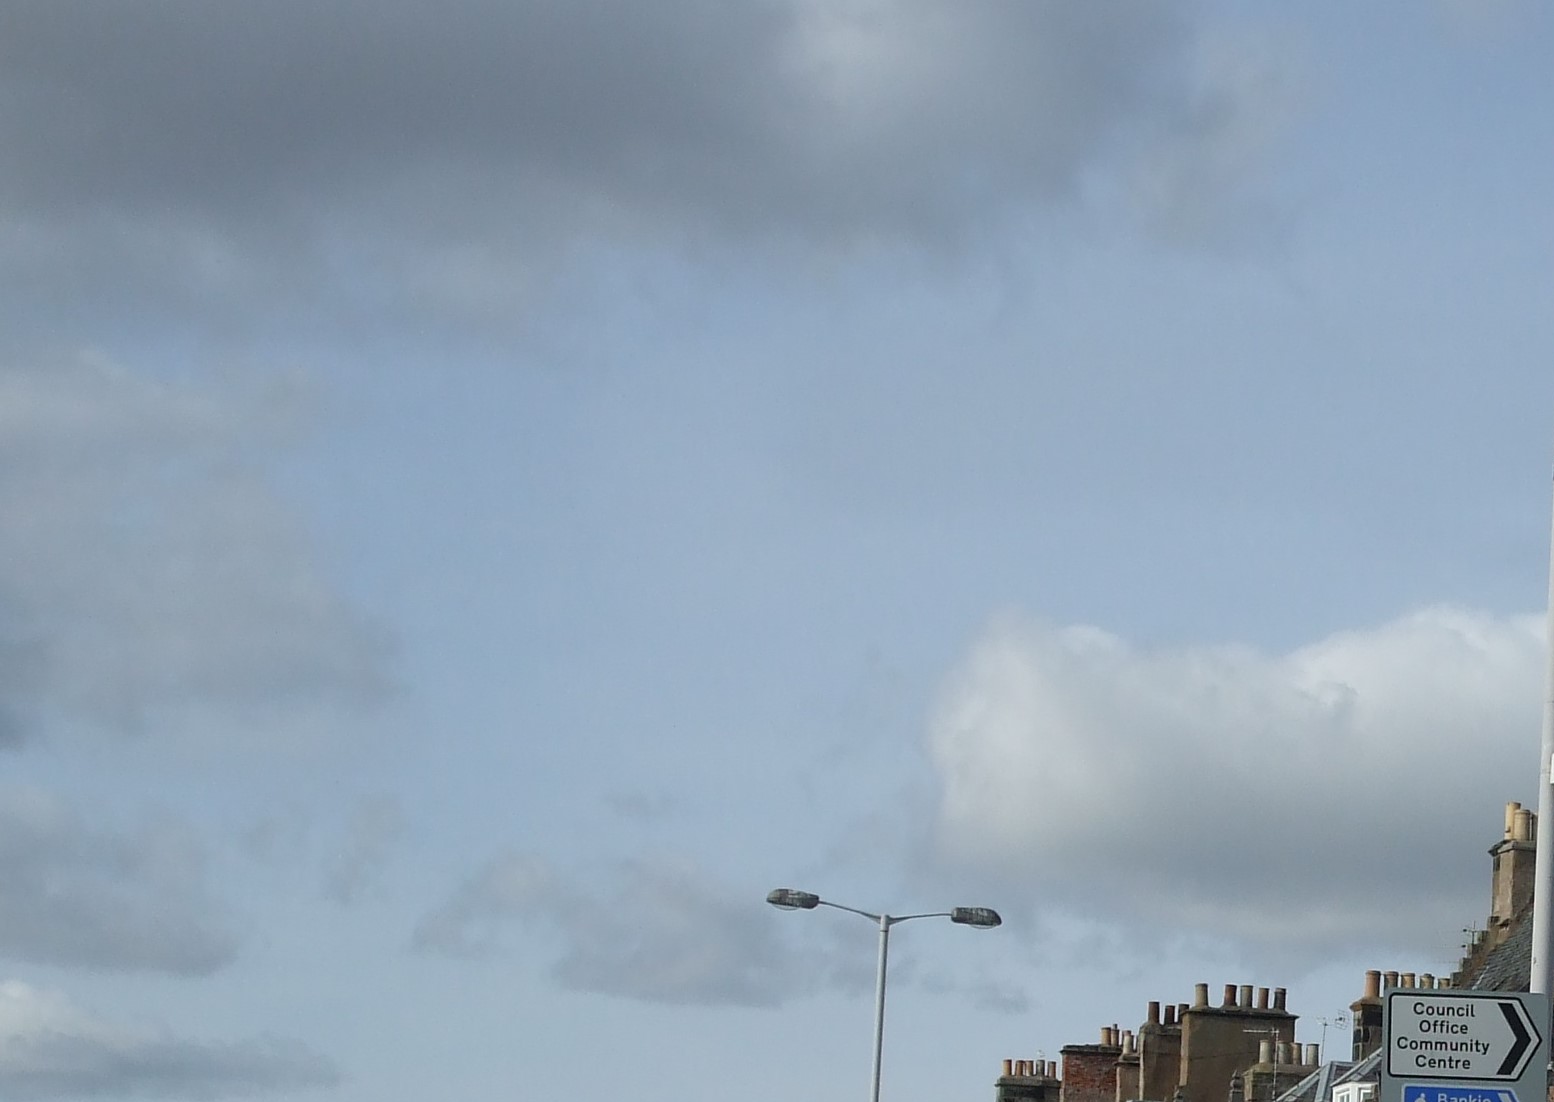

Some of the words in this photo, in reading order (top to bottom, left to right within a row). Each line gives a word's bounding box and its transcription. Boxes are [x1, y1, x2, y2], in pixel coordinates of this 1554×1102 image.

[1412, 1002, 1476, 1018] Council
[1418, 1019, 1469, 1035] Office
[1396, 1036, 1490, 1055] Community
[1414, 1054, 1471, 1070] Centre
